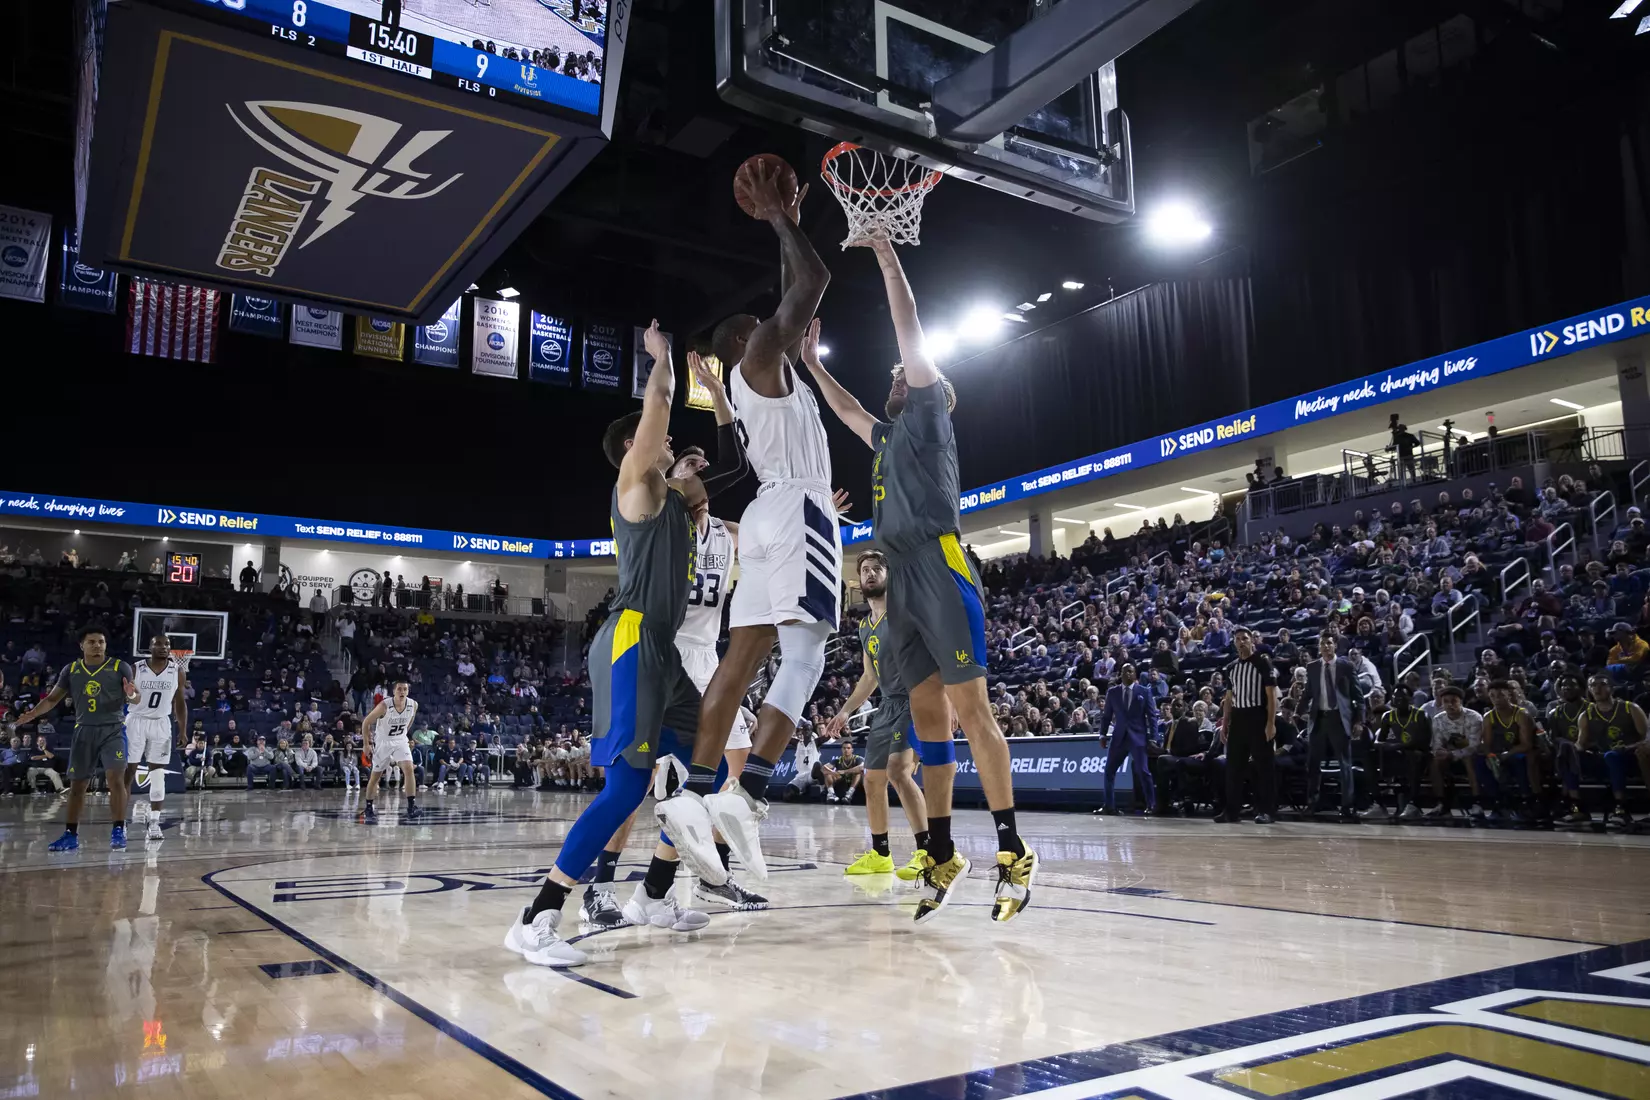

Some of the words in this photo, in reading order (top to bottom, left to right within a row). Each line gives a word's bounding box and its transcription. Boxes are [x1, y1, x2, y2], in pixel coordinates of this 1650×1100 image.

[292, 0, 307, 27] 8
[271, 25, 298, 41] FLS
[308, 36, 316, 47] 2
[368, 22, 418, 56] 15:40
[361, 51, 386, 65] 1ST
[391, 56, 423, 75] HALF
[476, 54, 489, 78] 9
[458, 79, 481, 93] FLS
[0, 213, 36, 228] 2014
[215, 166, 322, 278] LANCERS
[0, 270, 29, 280] VISION
[0, 277, 42, 288] RNAMENT
[60, 283, 113, 298] CHAMPIONS
[233, 309, 281, 323] CHAMPIONS
[484, 305, 509, 317] 2016
[295, 320, 314, 328] WEST
[314, 323, 340, 332] REGION
[371, 319, 392, 329] NCAA
[476, 321, 516, 333] BASKETBALL
[540, 314, 564, 326] 2017
[296, 327, 337, 338] CHAMPIONS
[532, 329, 572, 342] BASKETBALL
[535, 323, 567, 334] WOMEN'S
[592, 324, 616, 336] 2017
[1562, 313, 1625, 345] SEND
[360, 332, 393, 342] DIVISION
[357, 345, 389, 355] RUNNER
[361, 339, 397, 350] NATIONAL
[415, 342, 457, 355] CHAMPIONS
[475, 357, 516, 368] TOURNAMENT
[480, 352, 507, 360] DIVISION
[531, 362, 570, 373] CHAMPIONS
[586, 377, 619, 388] CHAMPIONS
[1295, 396, 1341, 420] Meeting
[1343, 380, 1377, 403] needs,
[1380, 367, 1440, 394] changing
[1444, 356, 1479, 377] lives
[1179, 429, 1215, 451] SEND
[1216, 415, 1257, 441] Relief
[1021, 479, 1038, 492] Text
[1038, 473, 1061, 488] SEND
[1062, 464, 1093, 480] RELIEF
[1093, 462, 1103, 473] to
[1103, 453, 1132, 470] 888111
[959, 494, 979, 509] END
[980, 485, 1007, 504] Relief
[8, 496, 40, 510] needs,
[44, 499, 96, 517] changing
[98, 504, 126, 517] lives
[179, 511, 217, 526] SEND
[219, 515, 258, 530] Relief
[295, 523, 315, 534] Text
[316, 525, 345, 537] SEND
[346, 528, 382, 540] RELIEF
[382, 531, 393, 540] to
[393, 533, 423, 543] 888111
[470, 537, 500, 551] SEND
[502, 540, 534, 554] Relief
[696, 553, 726, 570] NCERS
[170, 566, 193, 582] 20
[297, 575, 334, 583] EQUIPPED
[688, 573, 721, 608] 33
[141, 680, 172, 690] LANCERS
[87, 698, 97, 712] 3
[148, 691, 162, 708] 0
[388, 724, 406, 737] 25
[803, 756, 809, 766] 4
[955, 759, 970, 773] ext
[1010, 757, 1061, 773] RELIEF
[1062, 758, 1077, 773] to
